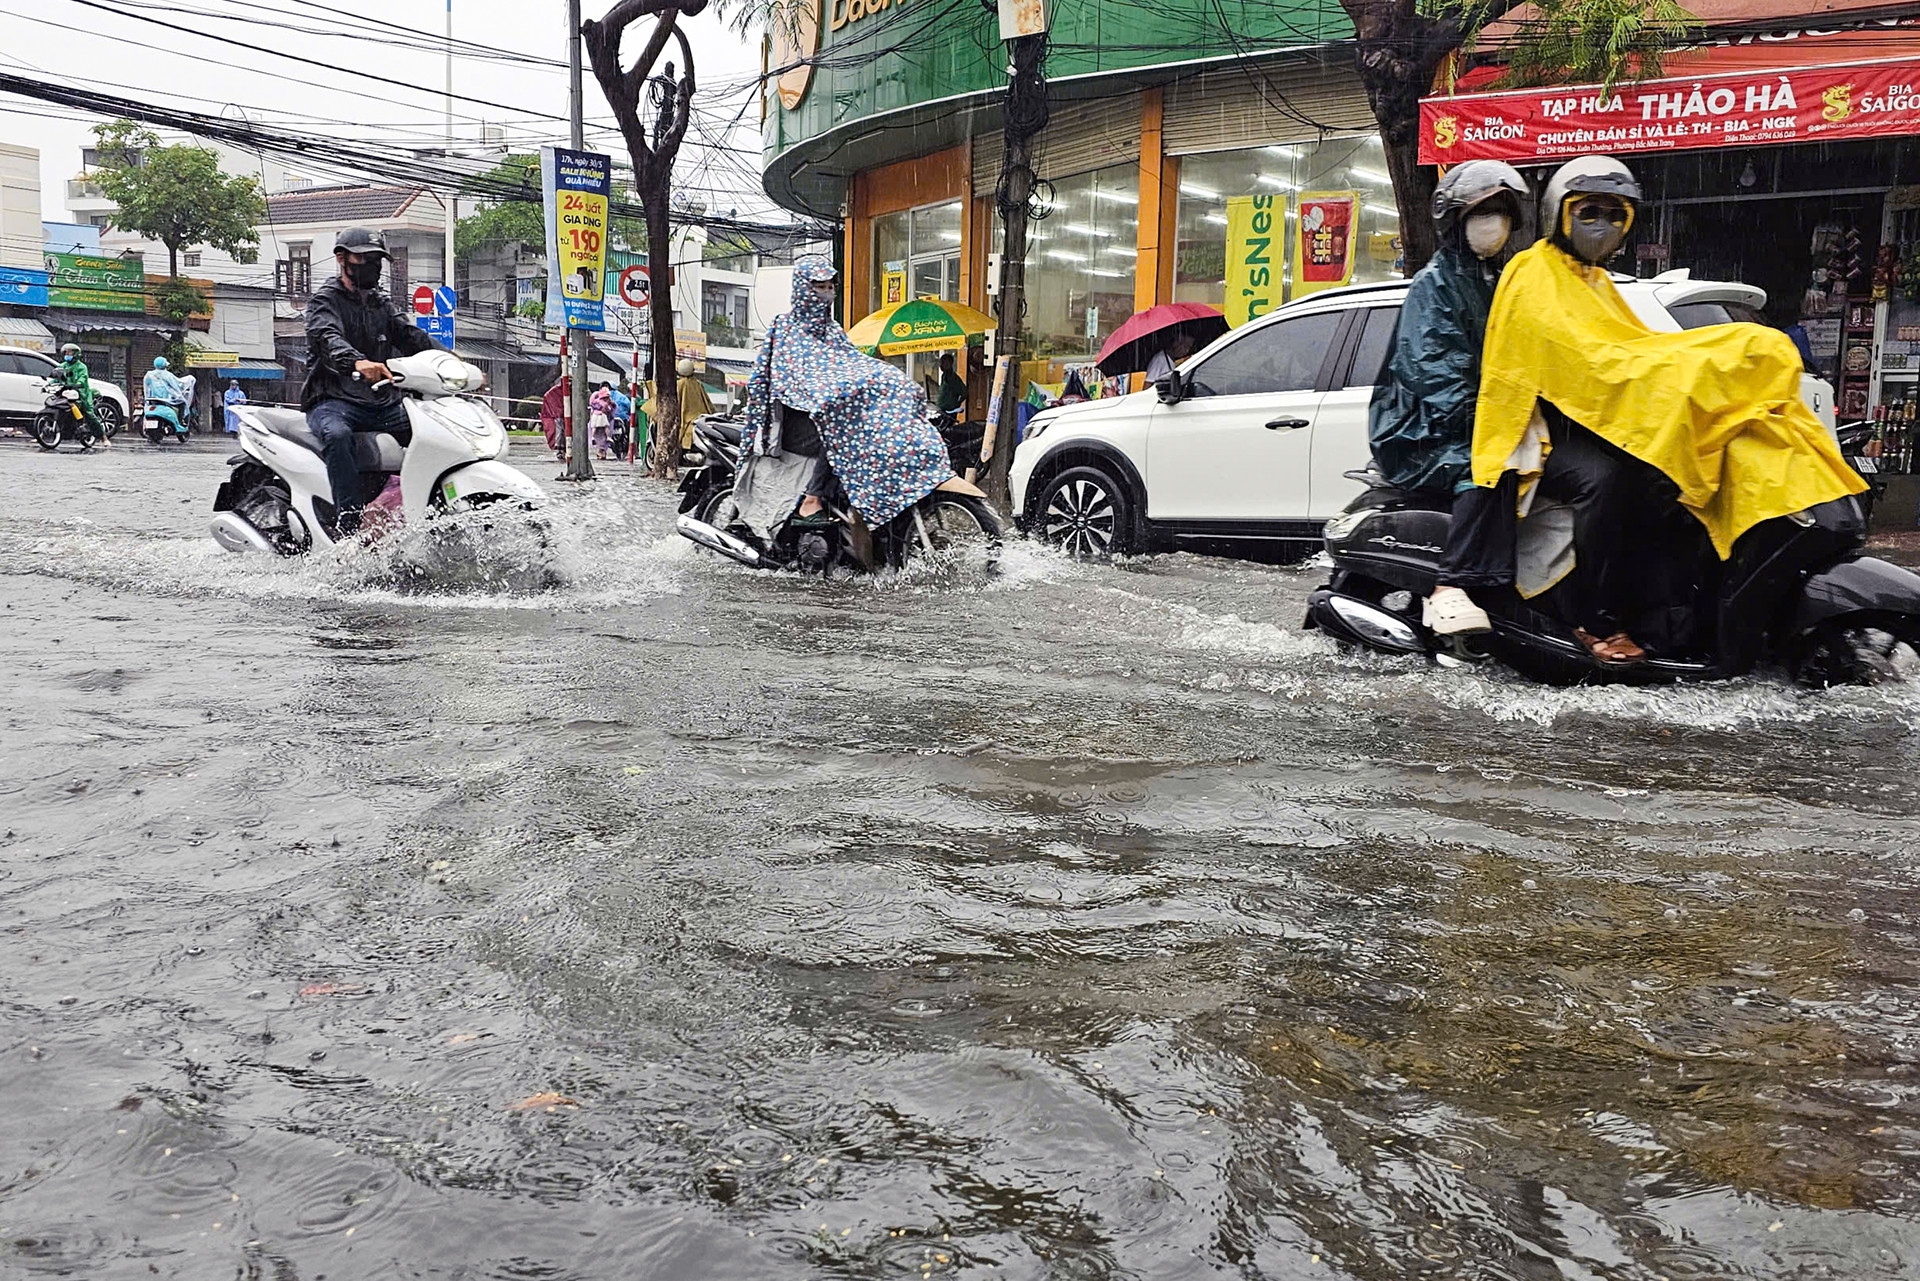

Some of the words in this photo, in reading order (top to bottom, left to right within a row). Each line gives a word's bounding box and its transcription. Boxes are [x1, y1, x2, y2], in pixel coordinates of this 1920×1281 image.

[1888, 84, 1912, 96] BIA
[1541, 99, 1577, 122] TẠP
[1637, 83, 1736, 121] THẢO
[1744, 76, 1798, 113] HÀ
[1484, 116, 1504, 126] BIA
[1463, 124, 1524, 142] SAIGON
[1537, 128, 1594, 146] CHUYÊN
[1596, 125, 1627, 142] BÁN
[1645, 121, 1665, 138] VÀ
[1691, 122, 1712, 135] TH
[1724, 119, 1750, 132] BIA
[1762, 116, 1797, 130] NGK
[563, 194, 584, 211] 24
[563, 214, 582, 224] GIA
[912, 325, 947, 335] XANH
